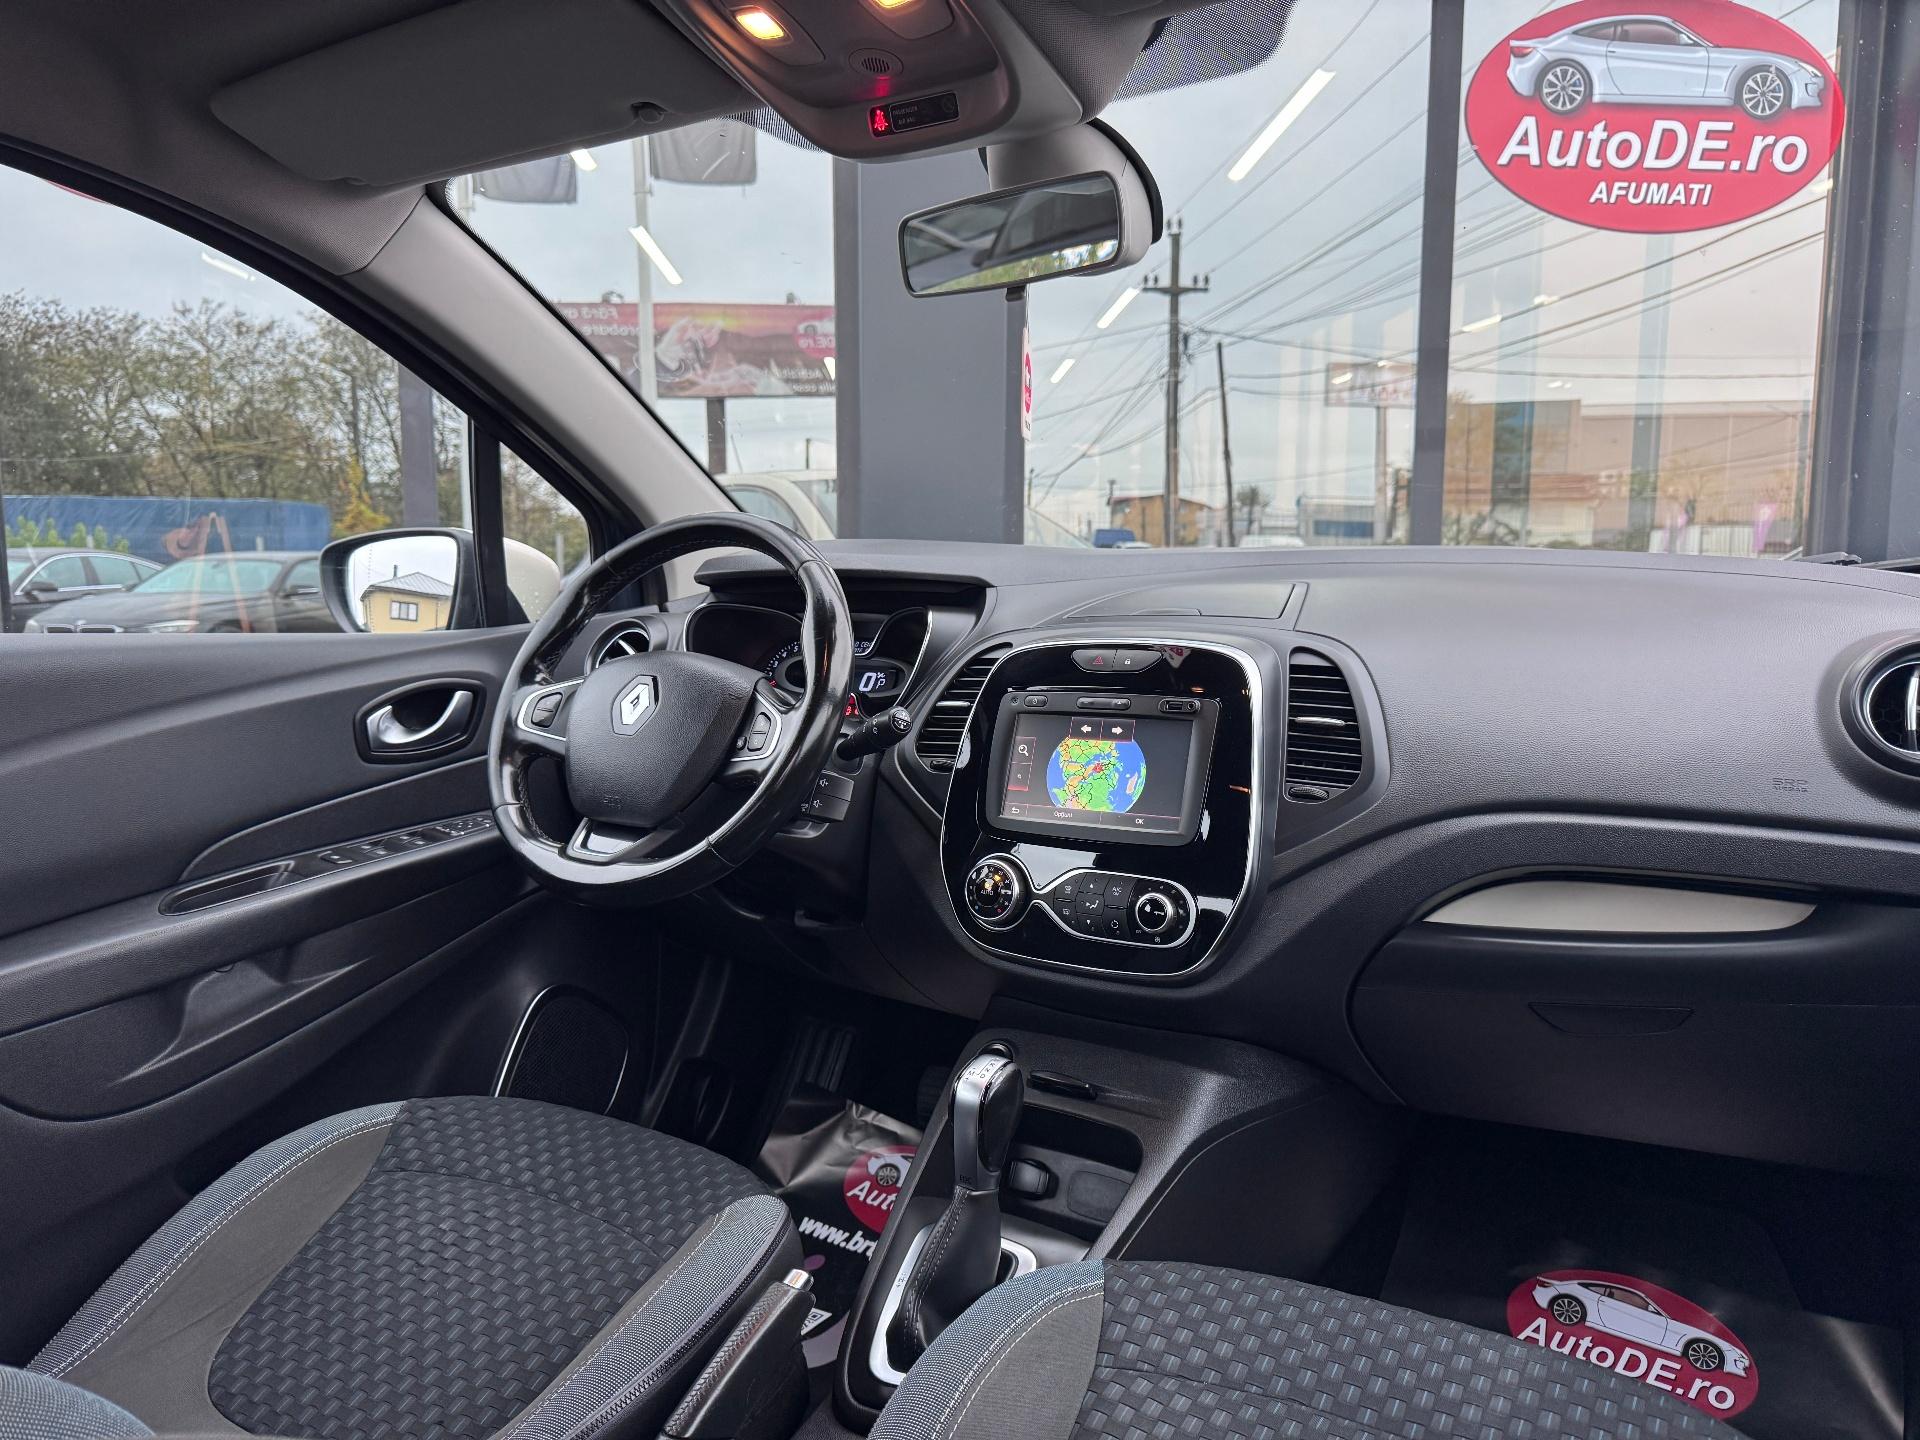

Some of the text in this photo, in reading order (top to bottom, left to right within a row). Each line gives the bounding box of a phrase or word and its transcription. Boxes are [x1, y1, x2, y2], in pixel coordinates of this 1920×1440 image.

[1496, 115, 1808, 173] AutoDE.ro
[1589, 182, 1712, 205] AFUMATI
[846, 1181, 898, 1212] Aut
[1516, 1316, 1736, 1411] AutoDE.ro
